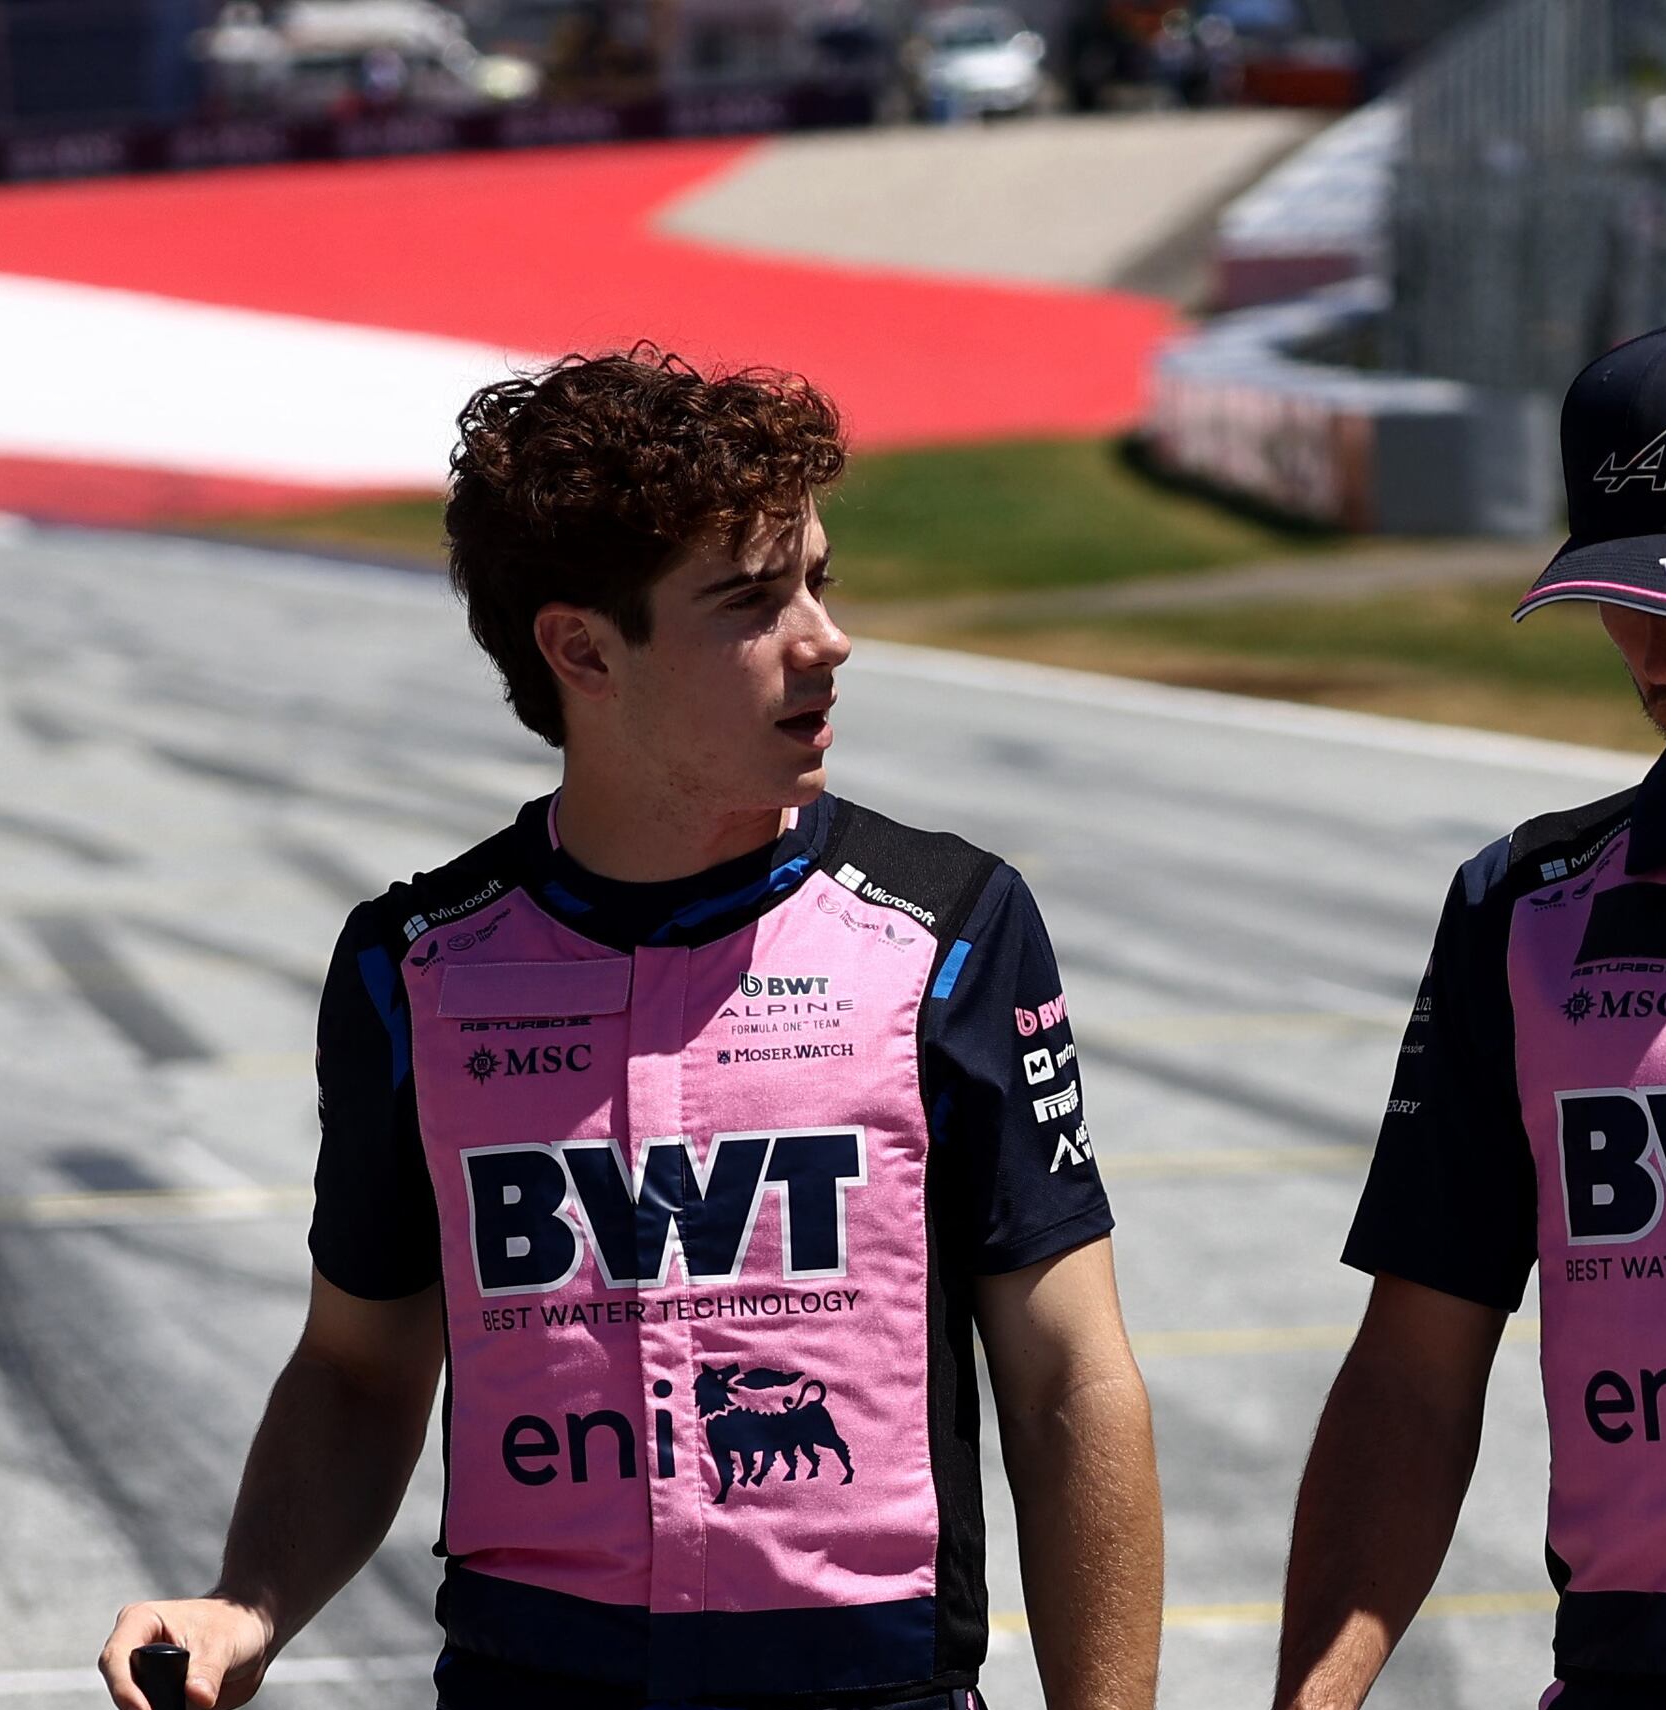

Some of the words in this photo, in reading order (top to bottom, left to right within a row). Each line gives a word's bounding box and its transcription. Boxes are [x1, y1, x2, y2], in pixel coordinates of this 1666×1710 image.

[430, 879, 504, 922] Microsoft
[862, 882, 935, 927] Microsoft
[767, 976, 829, 997] BWT
[718, 1000, 854, 1019] ALPINE
[731, 1022, 778, 1035] FORMULA
[814, 1018, 840, 1029] TEAM
[504, 1044, 592, 1076] MSC
[460, 1125, 869, 1297] BWT
[1566, 1257, 1613, 1282] BEST
[482, 1306, 532, 1332] BEST
[541, 1300, 647, 1328] WATER
[657, 1289, 862, 1323] TECHNOLOGY
[502, 1379, 676, 1487] eni
